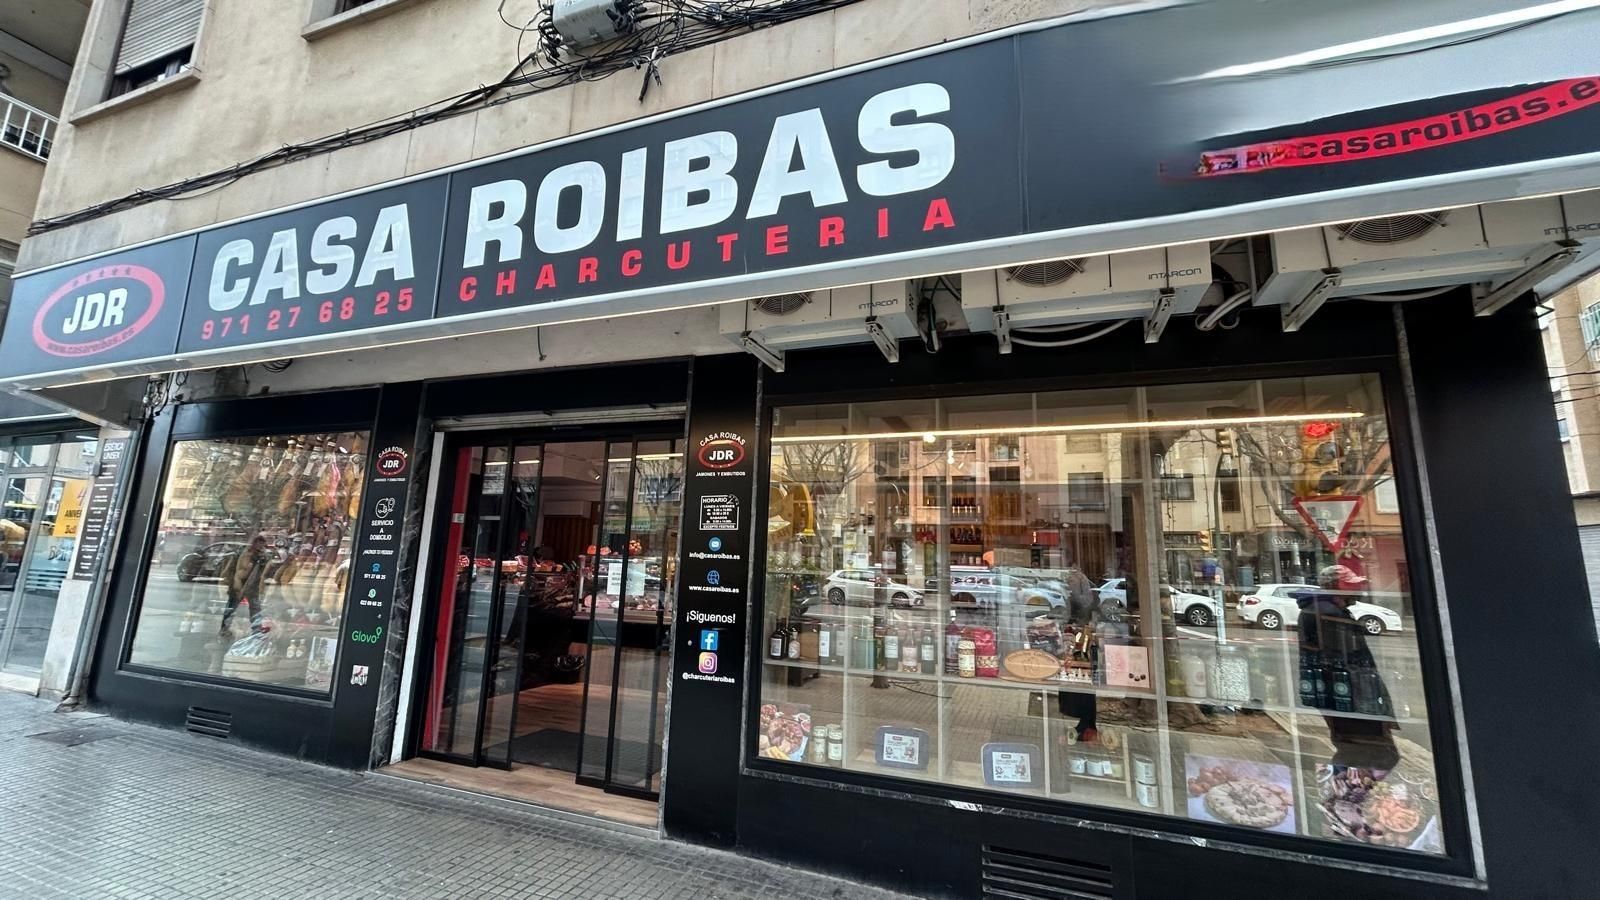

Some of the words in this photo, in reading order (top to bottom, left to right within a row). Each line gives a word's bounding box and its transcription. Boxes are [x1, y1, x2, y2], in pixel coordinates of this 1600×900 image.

[1297, 80, 1599, 159] casaroibas.e
[208, 203, 414, 311] CASA
[462, 82, 956, 269] ROIBAS
[459, 197, 956, 302] CHARCUTERIA
[62, 288, 128, 334] JDR
[201, 308, 249, 340] 971
[267, 306, 301, 331] 27
[319, 297, 355, 323] 68
[373, 287, 413, 316] 25
[700, 432, 719, 447] CASA
[719, 431, 746, 446] ROIBAS
[709, 450, 734, 461] JDR
[382, 459, 400, 468] JDR
[689, 552, 740, 560] info@casaroibas.es
[688, 585, 739, 593] www.casaroibas.es
[351, 630, 377, 643] Glovo
[682, 672, 735, 683] @charcuteriaroibas
